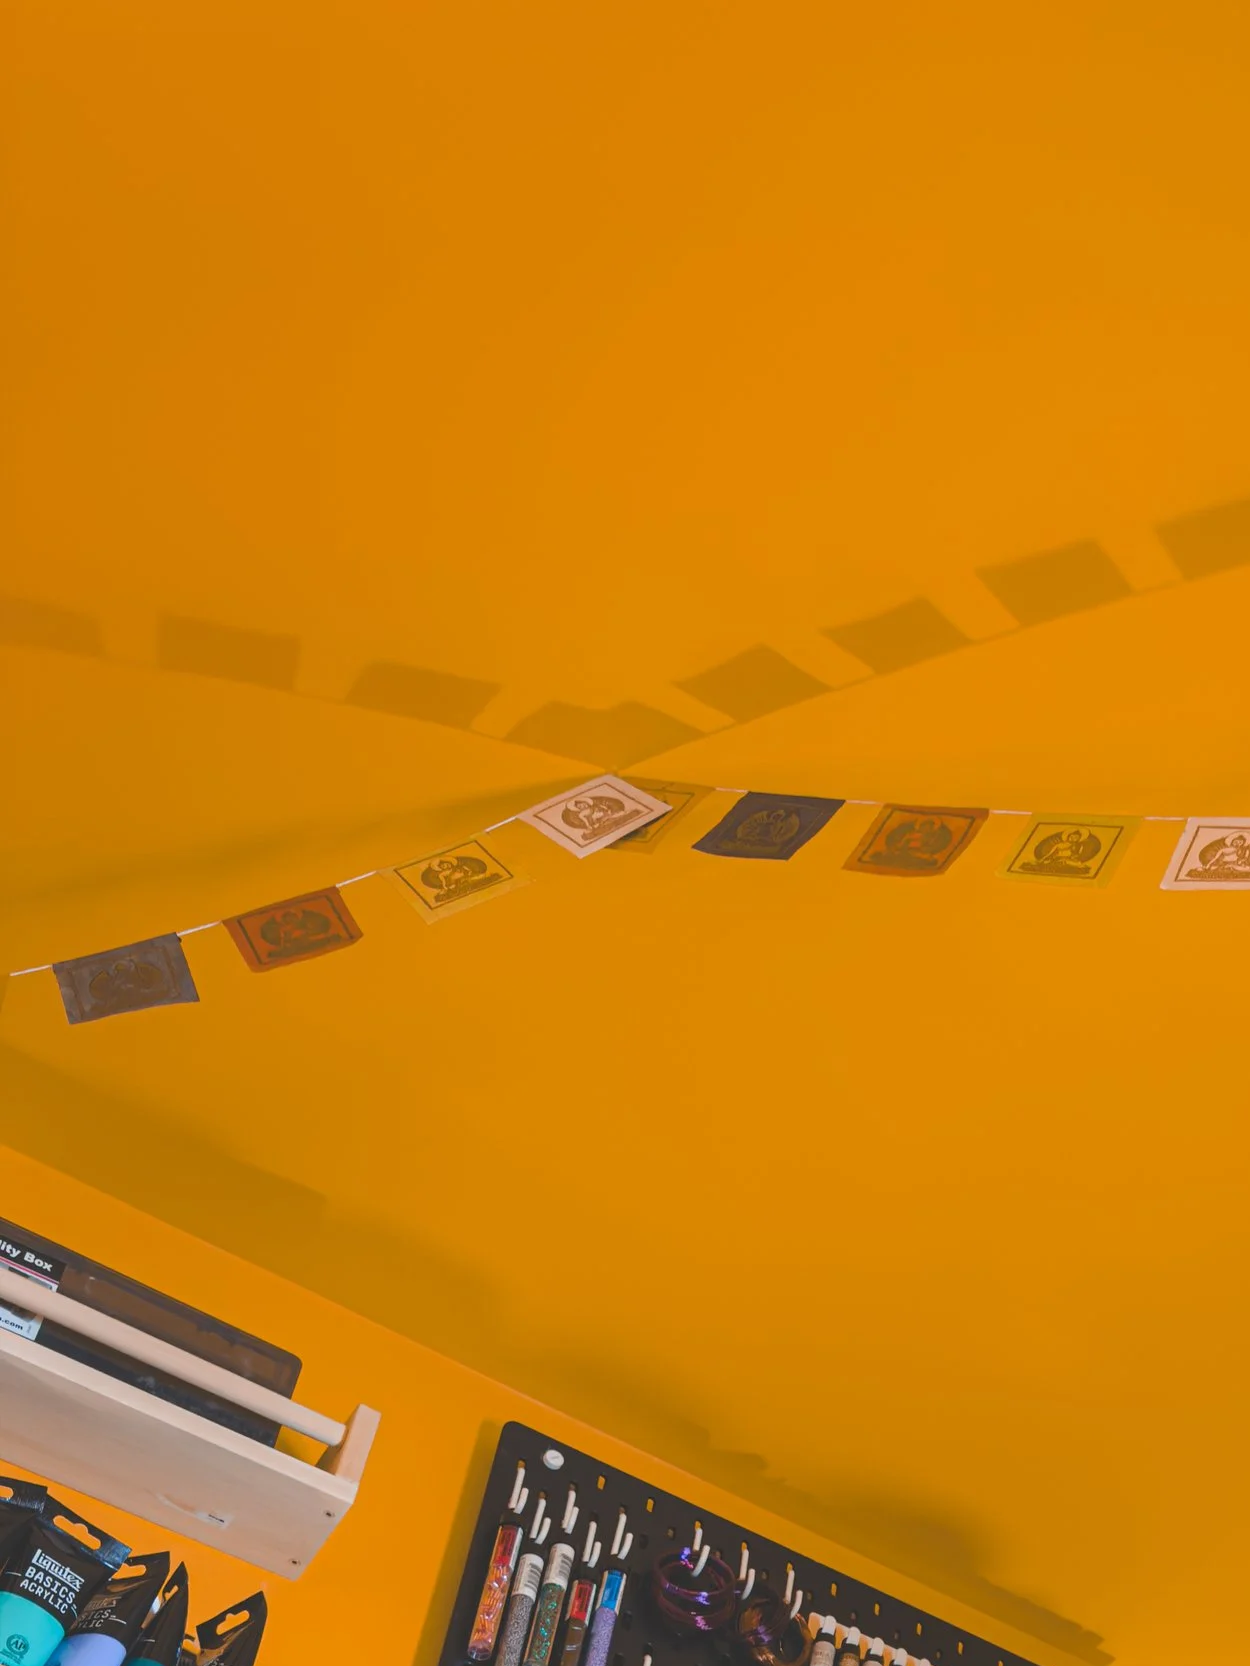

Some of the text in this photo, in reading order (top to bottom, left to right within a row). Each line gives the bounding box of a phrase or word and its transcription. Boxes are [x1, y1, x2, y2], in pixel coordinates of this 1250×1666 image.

[24, 1252, 53, 1273] Box
[25, 1566, 77, 1607] BASICS
[32, 1549, 85, 1592] Liquitex
[20, 1579, 69, 1614] ACRYLIC
